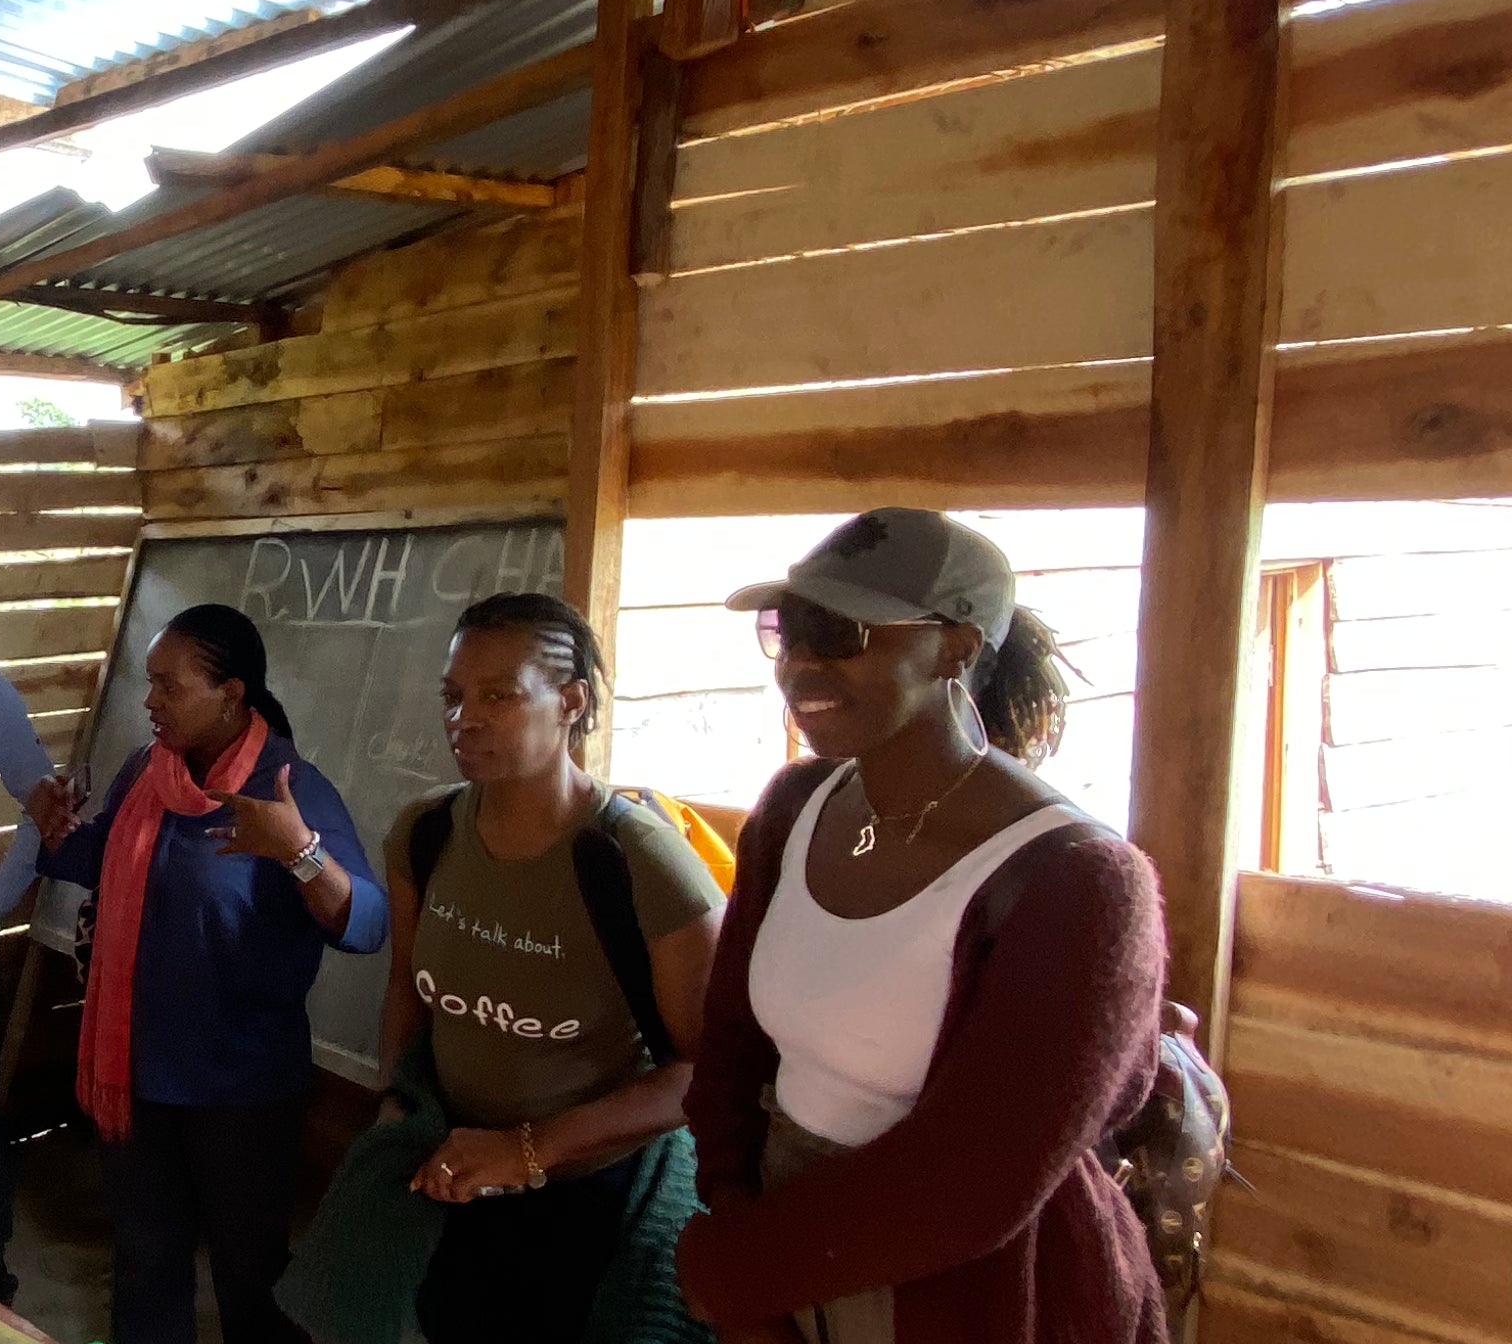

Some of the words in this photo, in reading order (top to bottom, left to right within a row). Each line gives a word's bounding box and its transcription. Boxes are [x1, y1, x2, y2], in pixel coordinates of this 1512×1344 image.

[238, 534, 416, 622] RWH
[429, 893, 466, 930] Let's
[472, 921, 508, 946] talk
[416, 970, 580, 1039] Coffee
